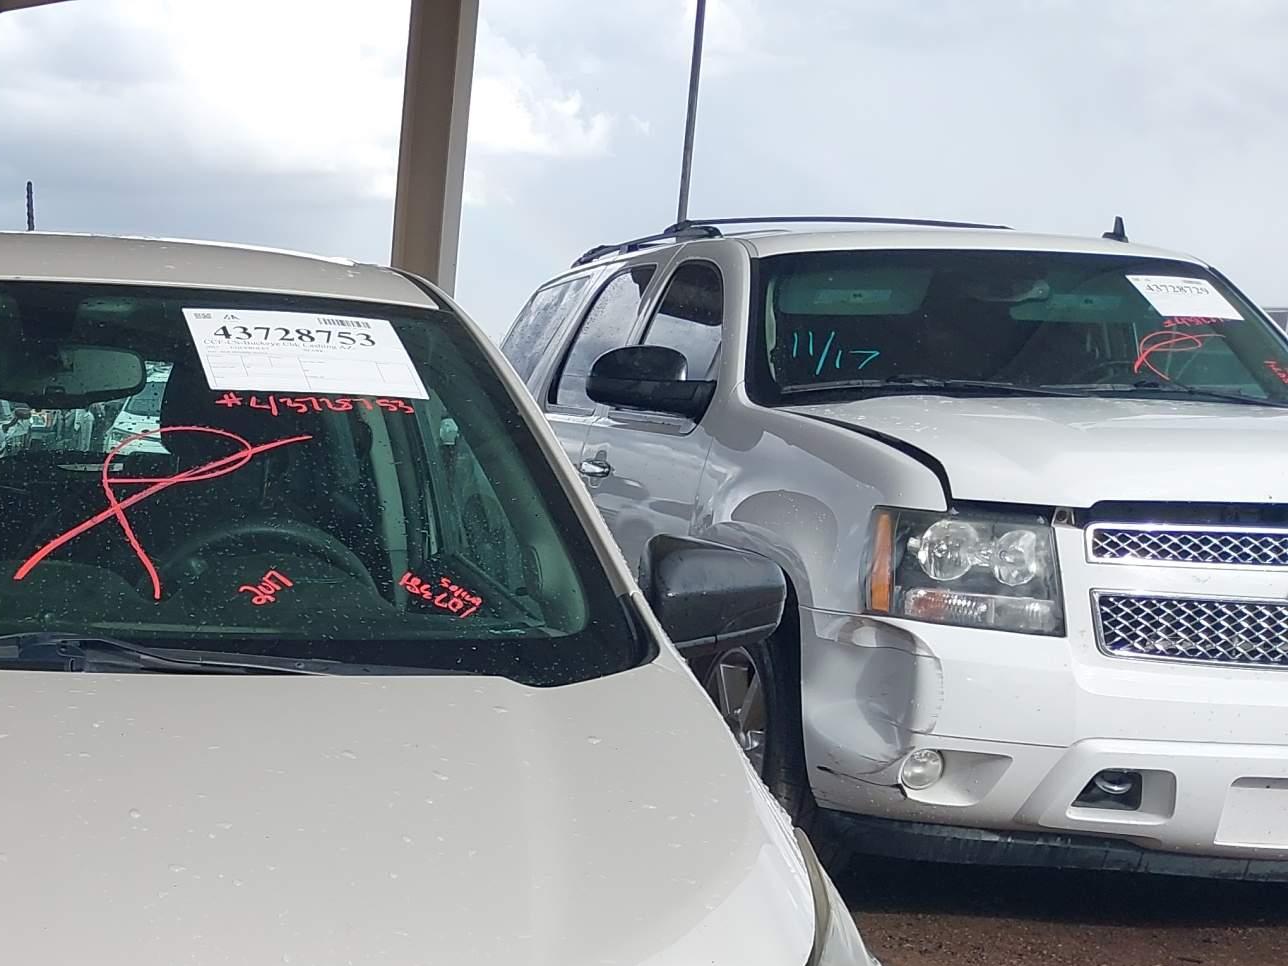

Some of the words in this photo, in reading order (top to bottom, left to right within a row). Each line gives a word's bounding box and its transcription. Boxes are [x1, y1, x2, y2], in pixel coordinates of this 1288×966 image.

[213, 325, 376, 347] 43728753
[792, 331, 880, 375] 11/17
[238, 569, 294, 606] 2017
